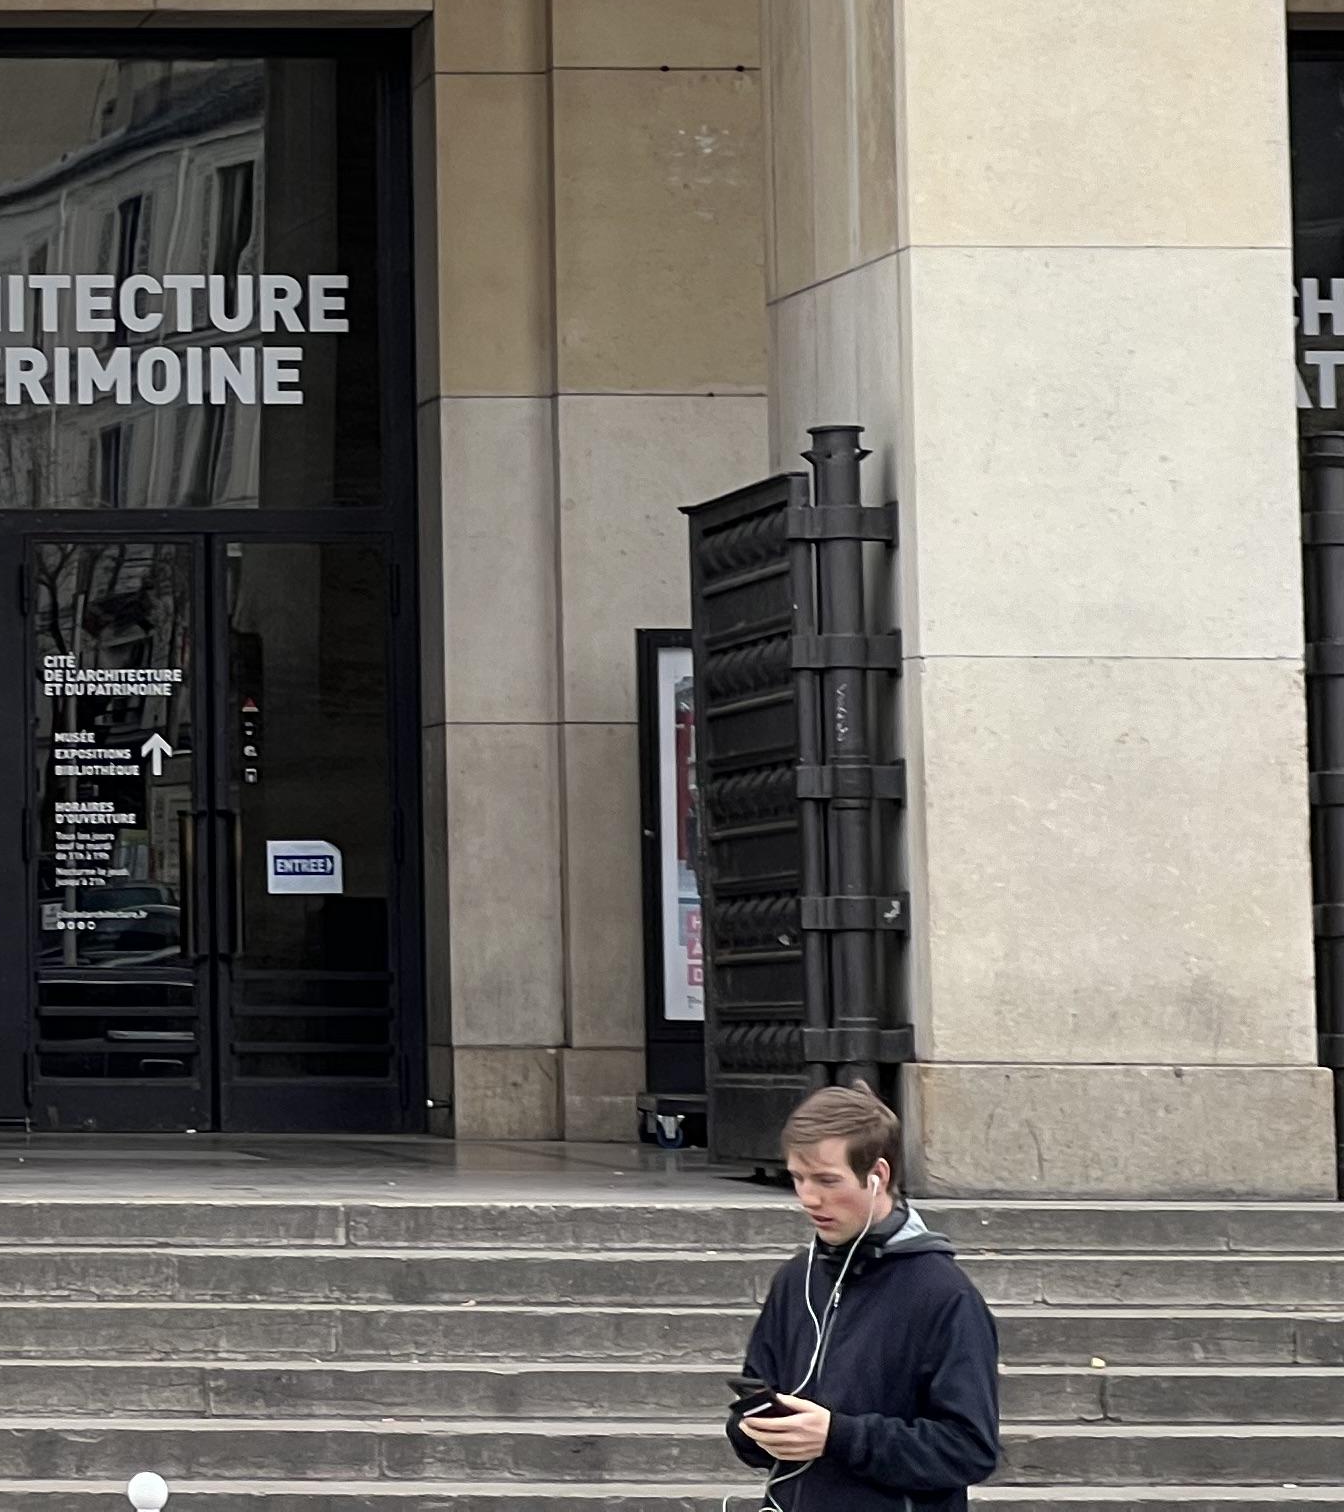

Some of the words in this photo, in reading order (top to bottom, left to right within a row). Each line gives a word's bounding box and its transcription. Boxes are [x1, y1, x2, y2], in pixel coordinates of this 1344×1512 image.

[43, 651, 76, 668] CITÉ
[44, 669, 64, 682] DE
[44, 683, 63, 696] ET
[64, 683, 85, 696] DU
[86, 683, 172, 696] PATRIMOINE
